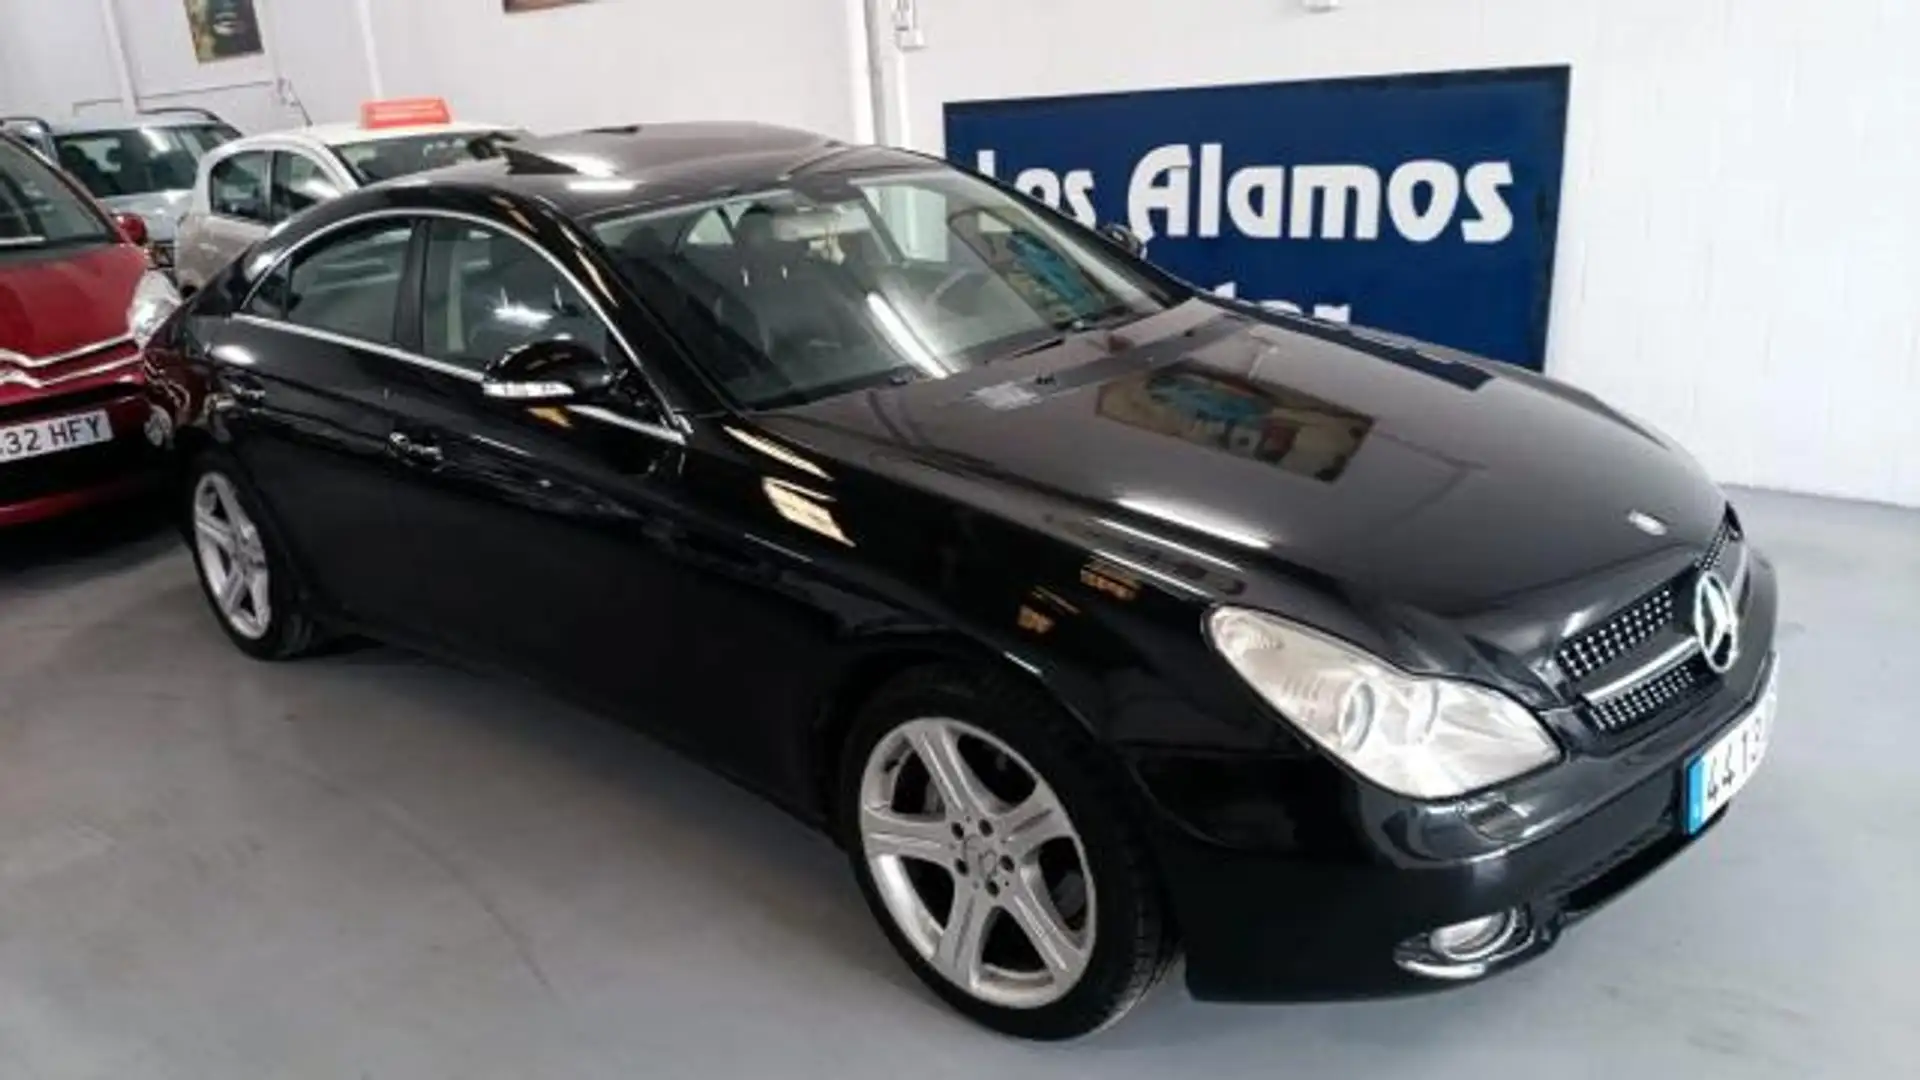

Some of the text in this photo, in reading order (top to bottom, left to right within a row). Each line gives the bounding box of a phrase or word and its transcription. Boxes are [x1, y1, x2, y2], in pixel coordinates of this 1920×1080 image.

[1128, 143, 1514, 243] Alamos
[0, 416, 99, 455] 32 HFY
